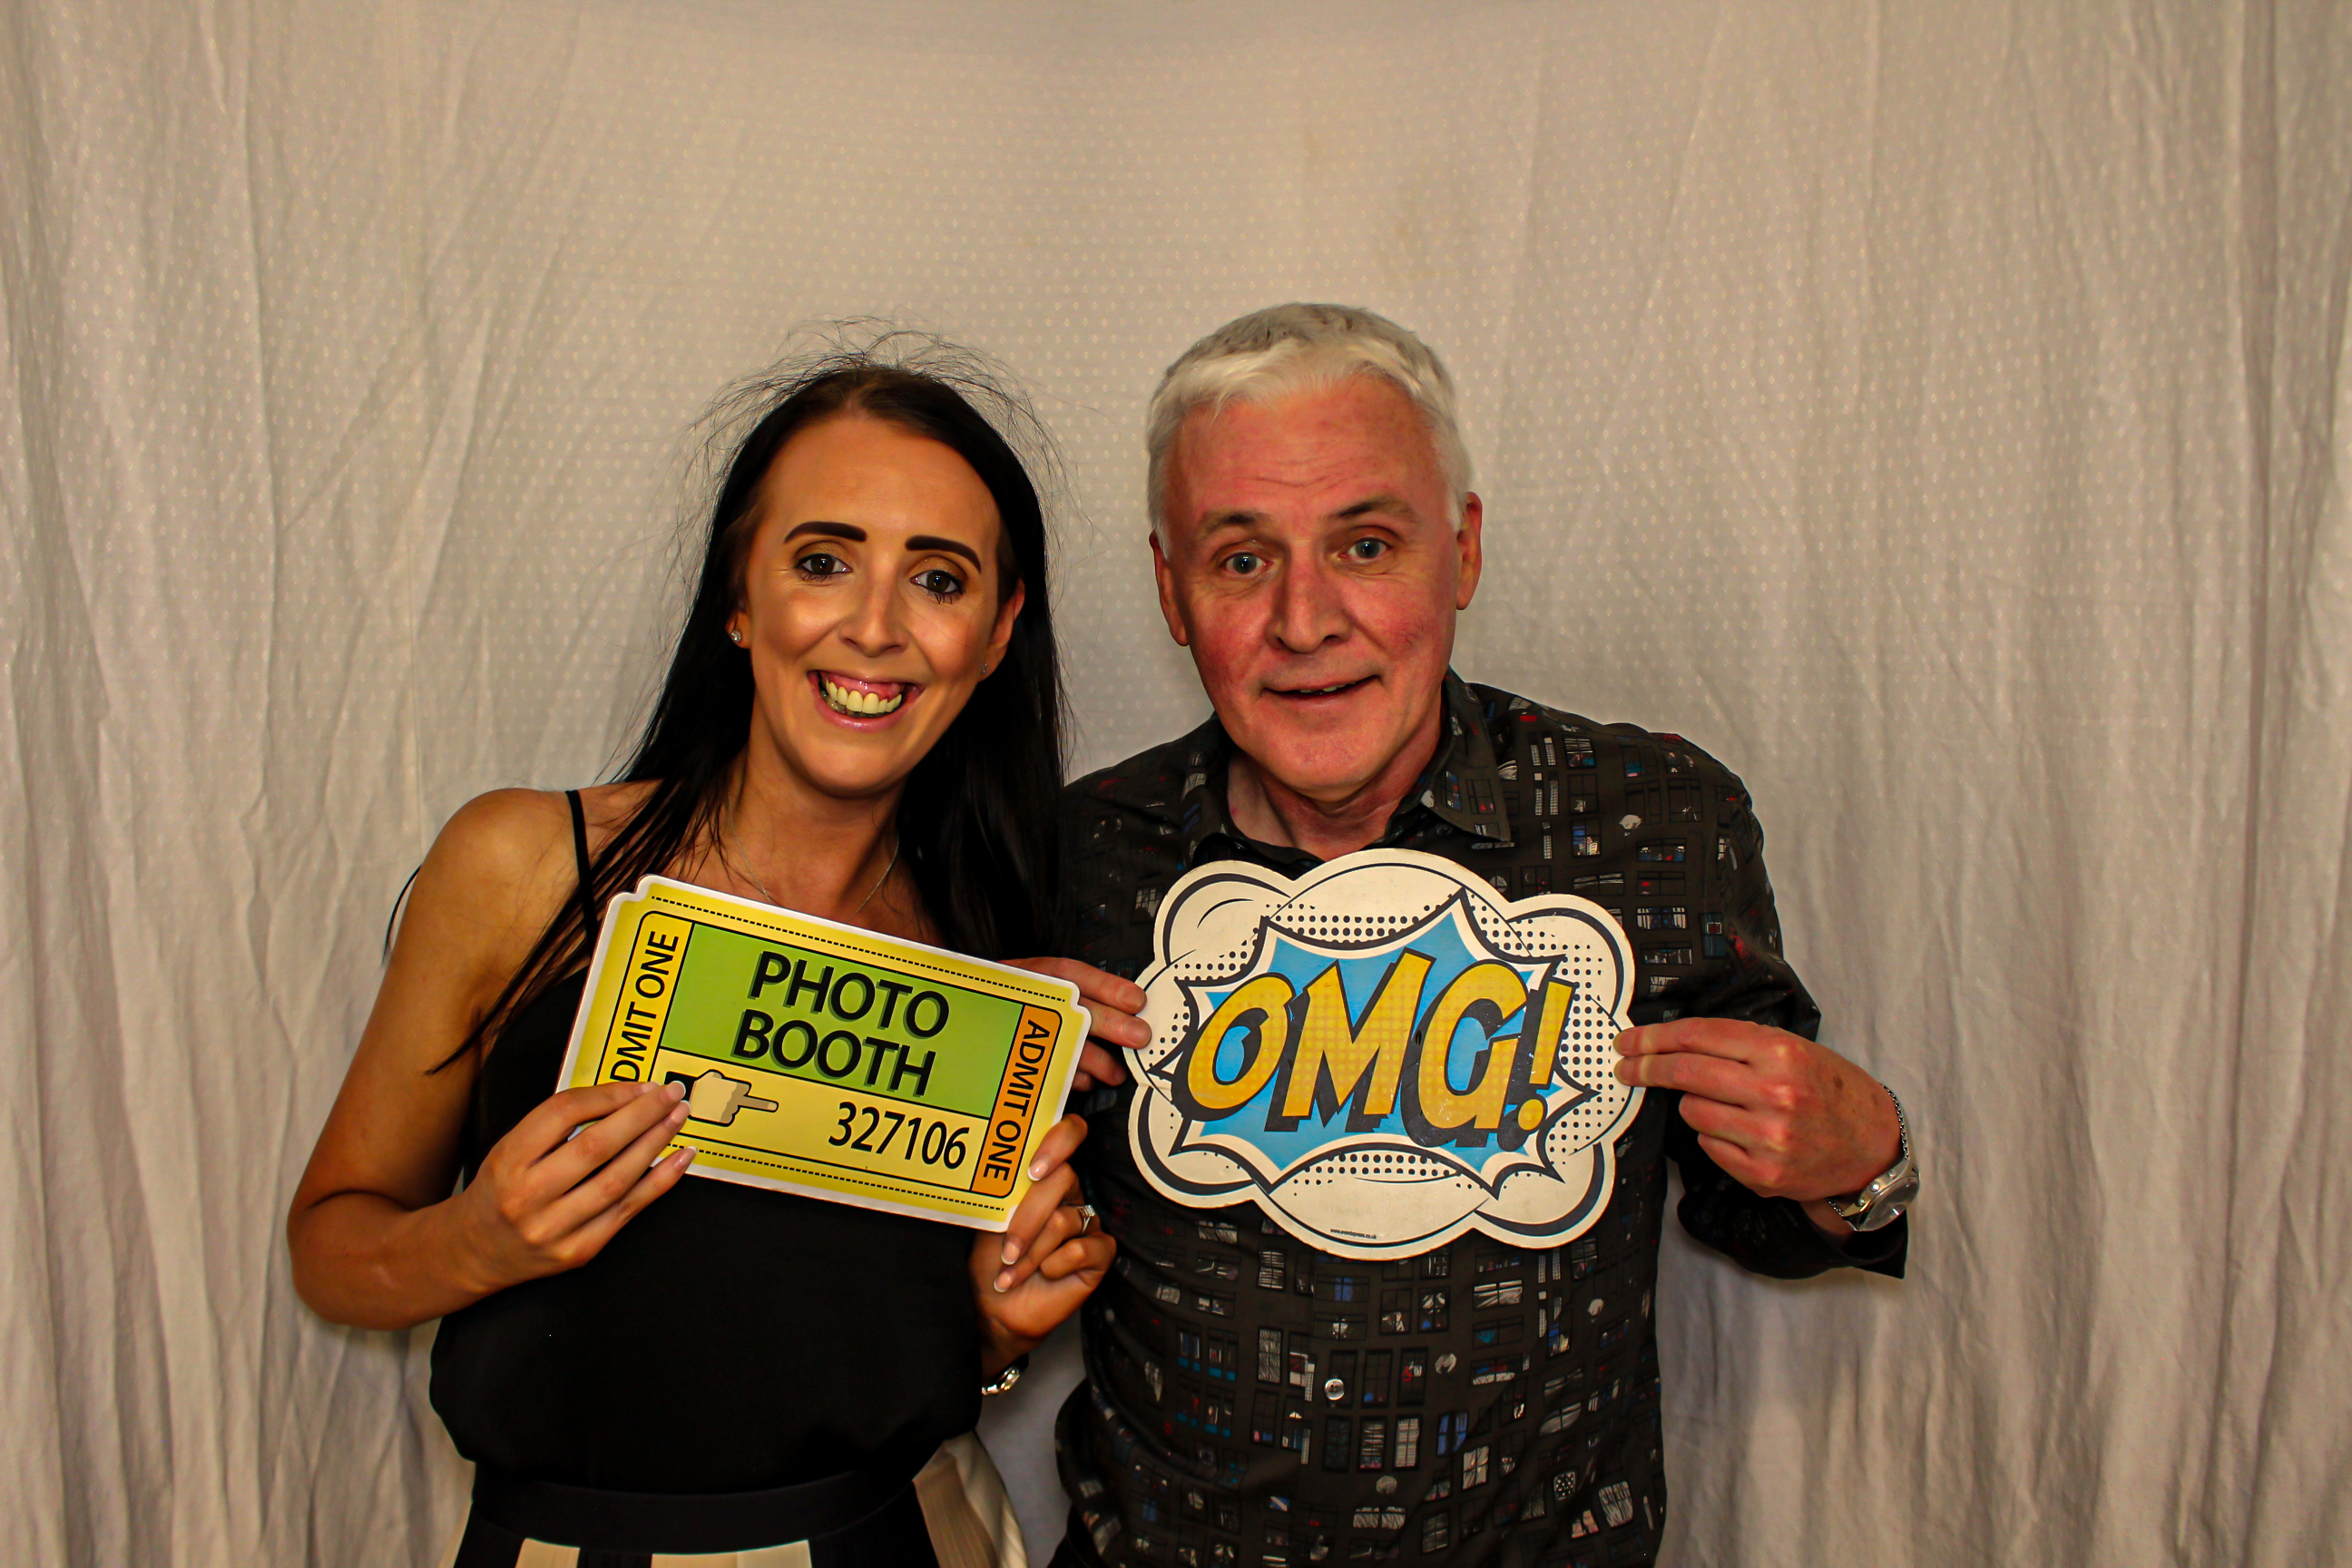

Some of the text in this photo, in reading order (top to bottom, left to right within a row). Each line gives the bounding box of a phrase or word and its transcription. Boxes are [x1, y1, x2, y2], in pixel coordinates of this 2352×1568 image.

[609, 930, 680, 1083] DMIT ONE
[731, 1008, 936, 1096] BOOTH
[749, 950, 950, 1038] PHOTO
[1178, 947, 1575, 1147] OMG!
[828, 1100, 970, 1170] 327106
[983, 1019, 1051, 1181] ADMIT ONE
